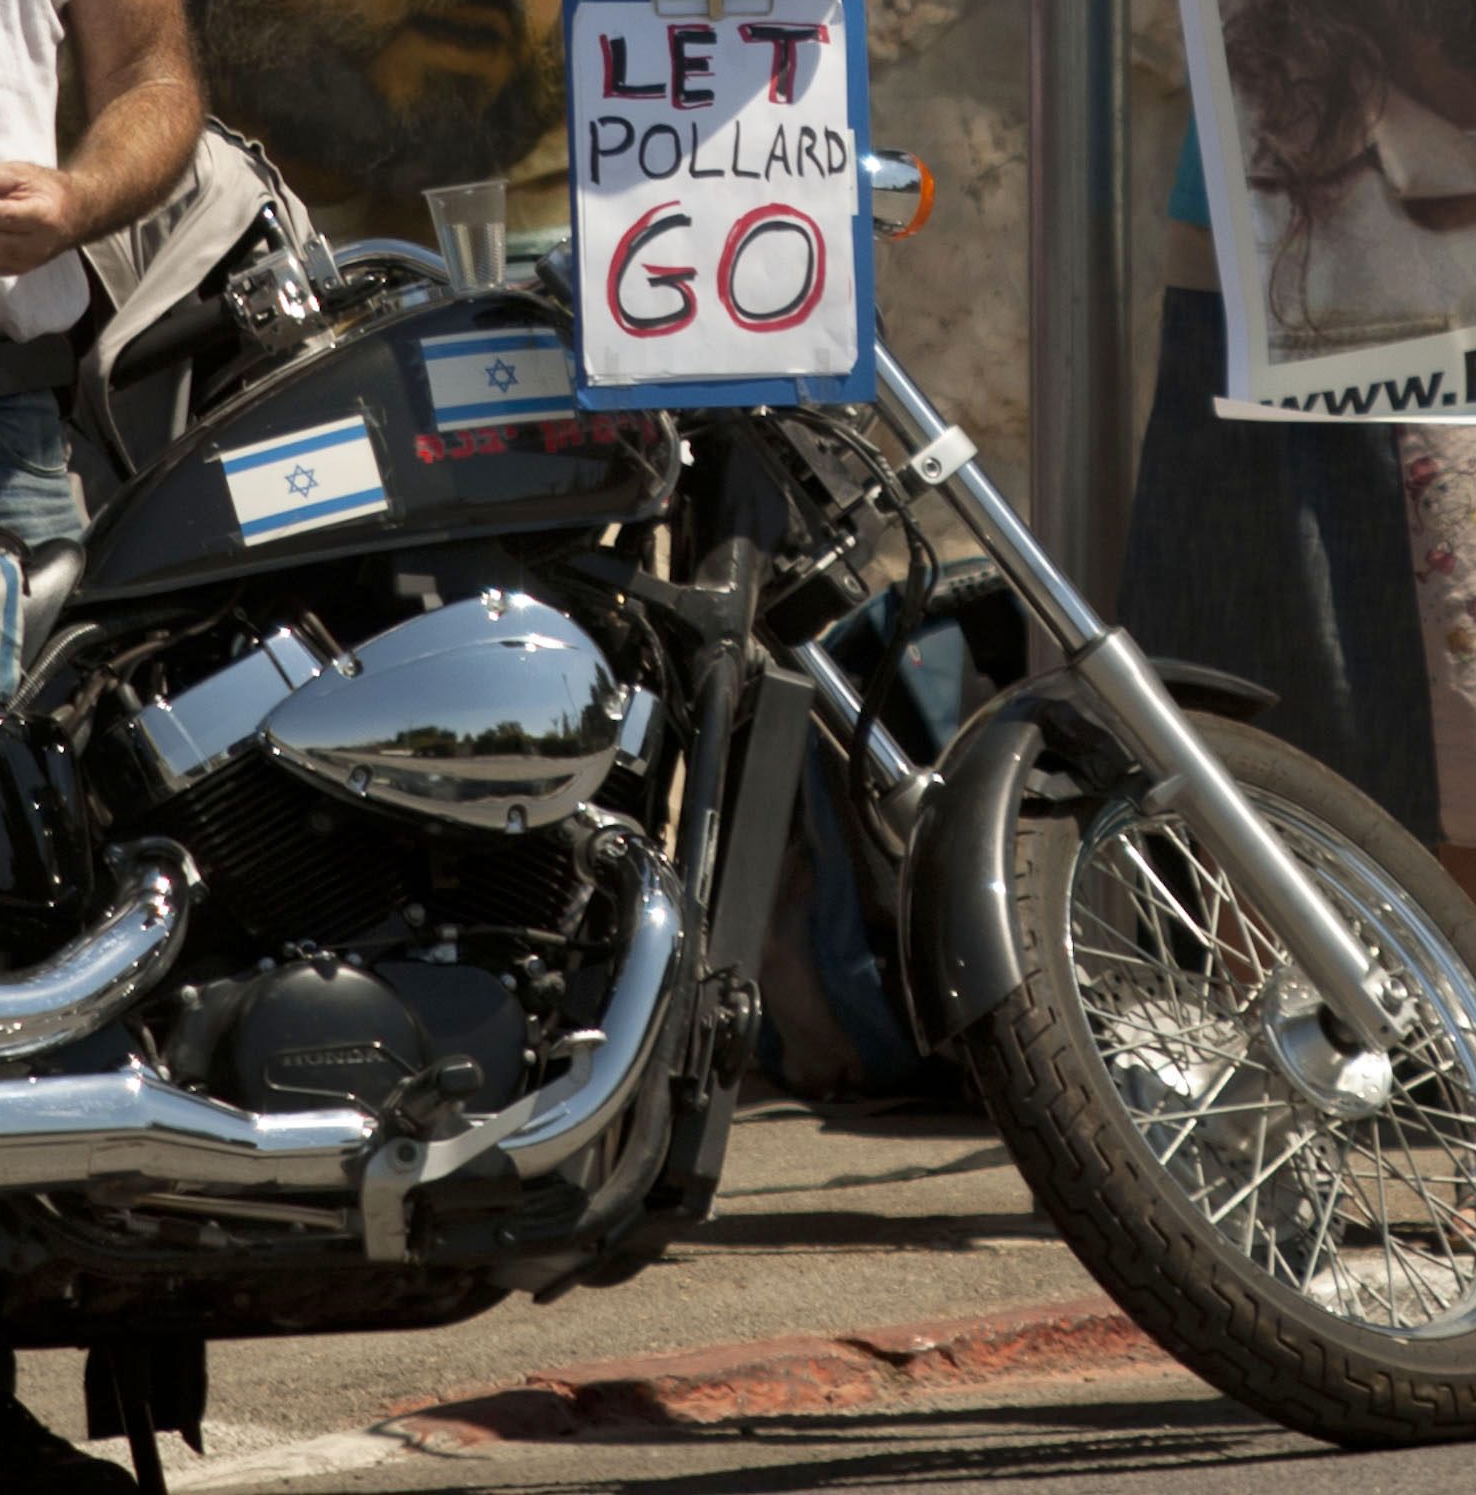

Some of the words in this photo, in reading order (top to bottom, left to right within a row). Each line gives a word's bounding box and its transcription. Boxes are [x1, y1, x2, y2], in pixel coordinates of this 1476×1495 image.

[601, 22, 829, 108] LET
[589, 115, 847, 186] POLLARD
[608, 200, 827, 338] GO
